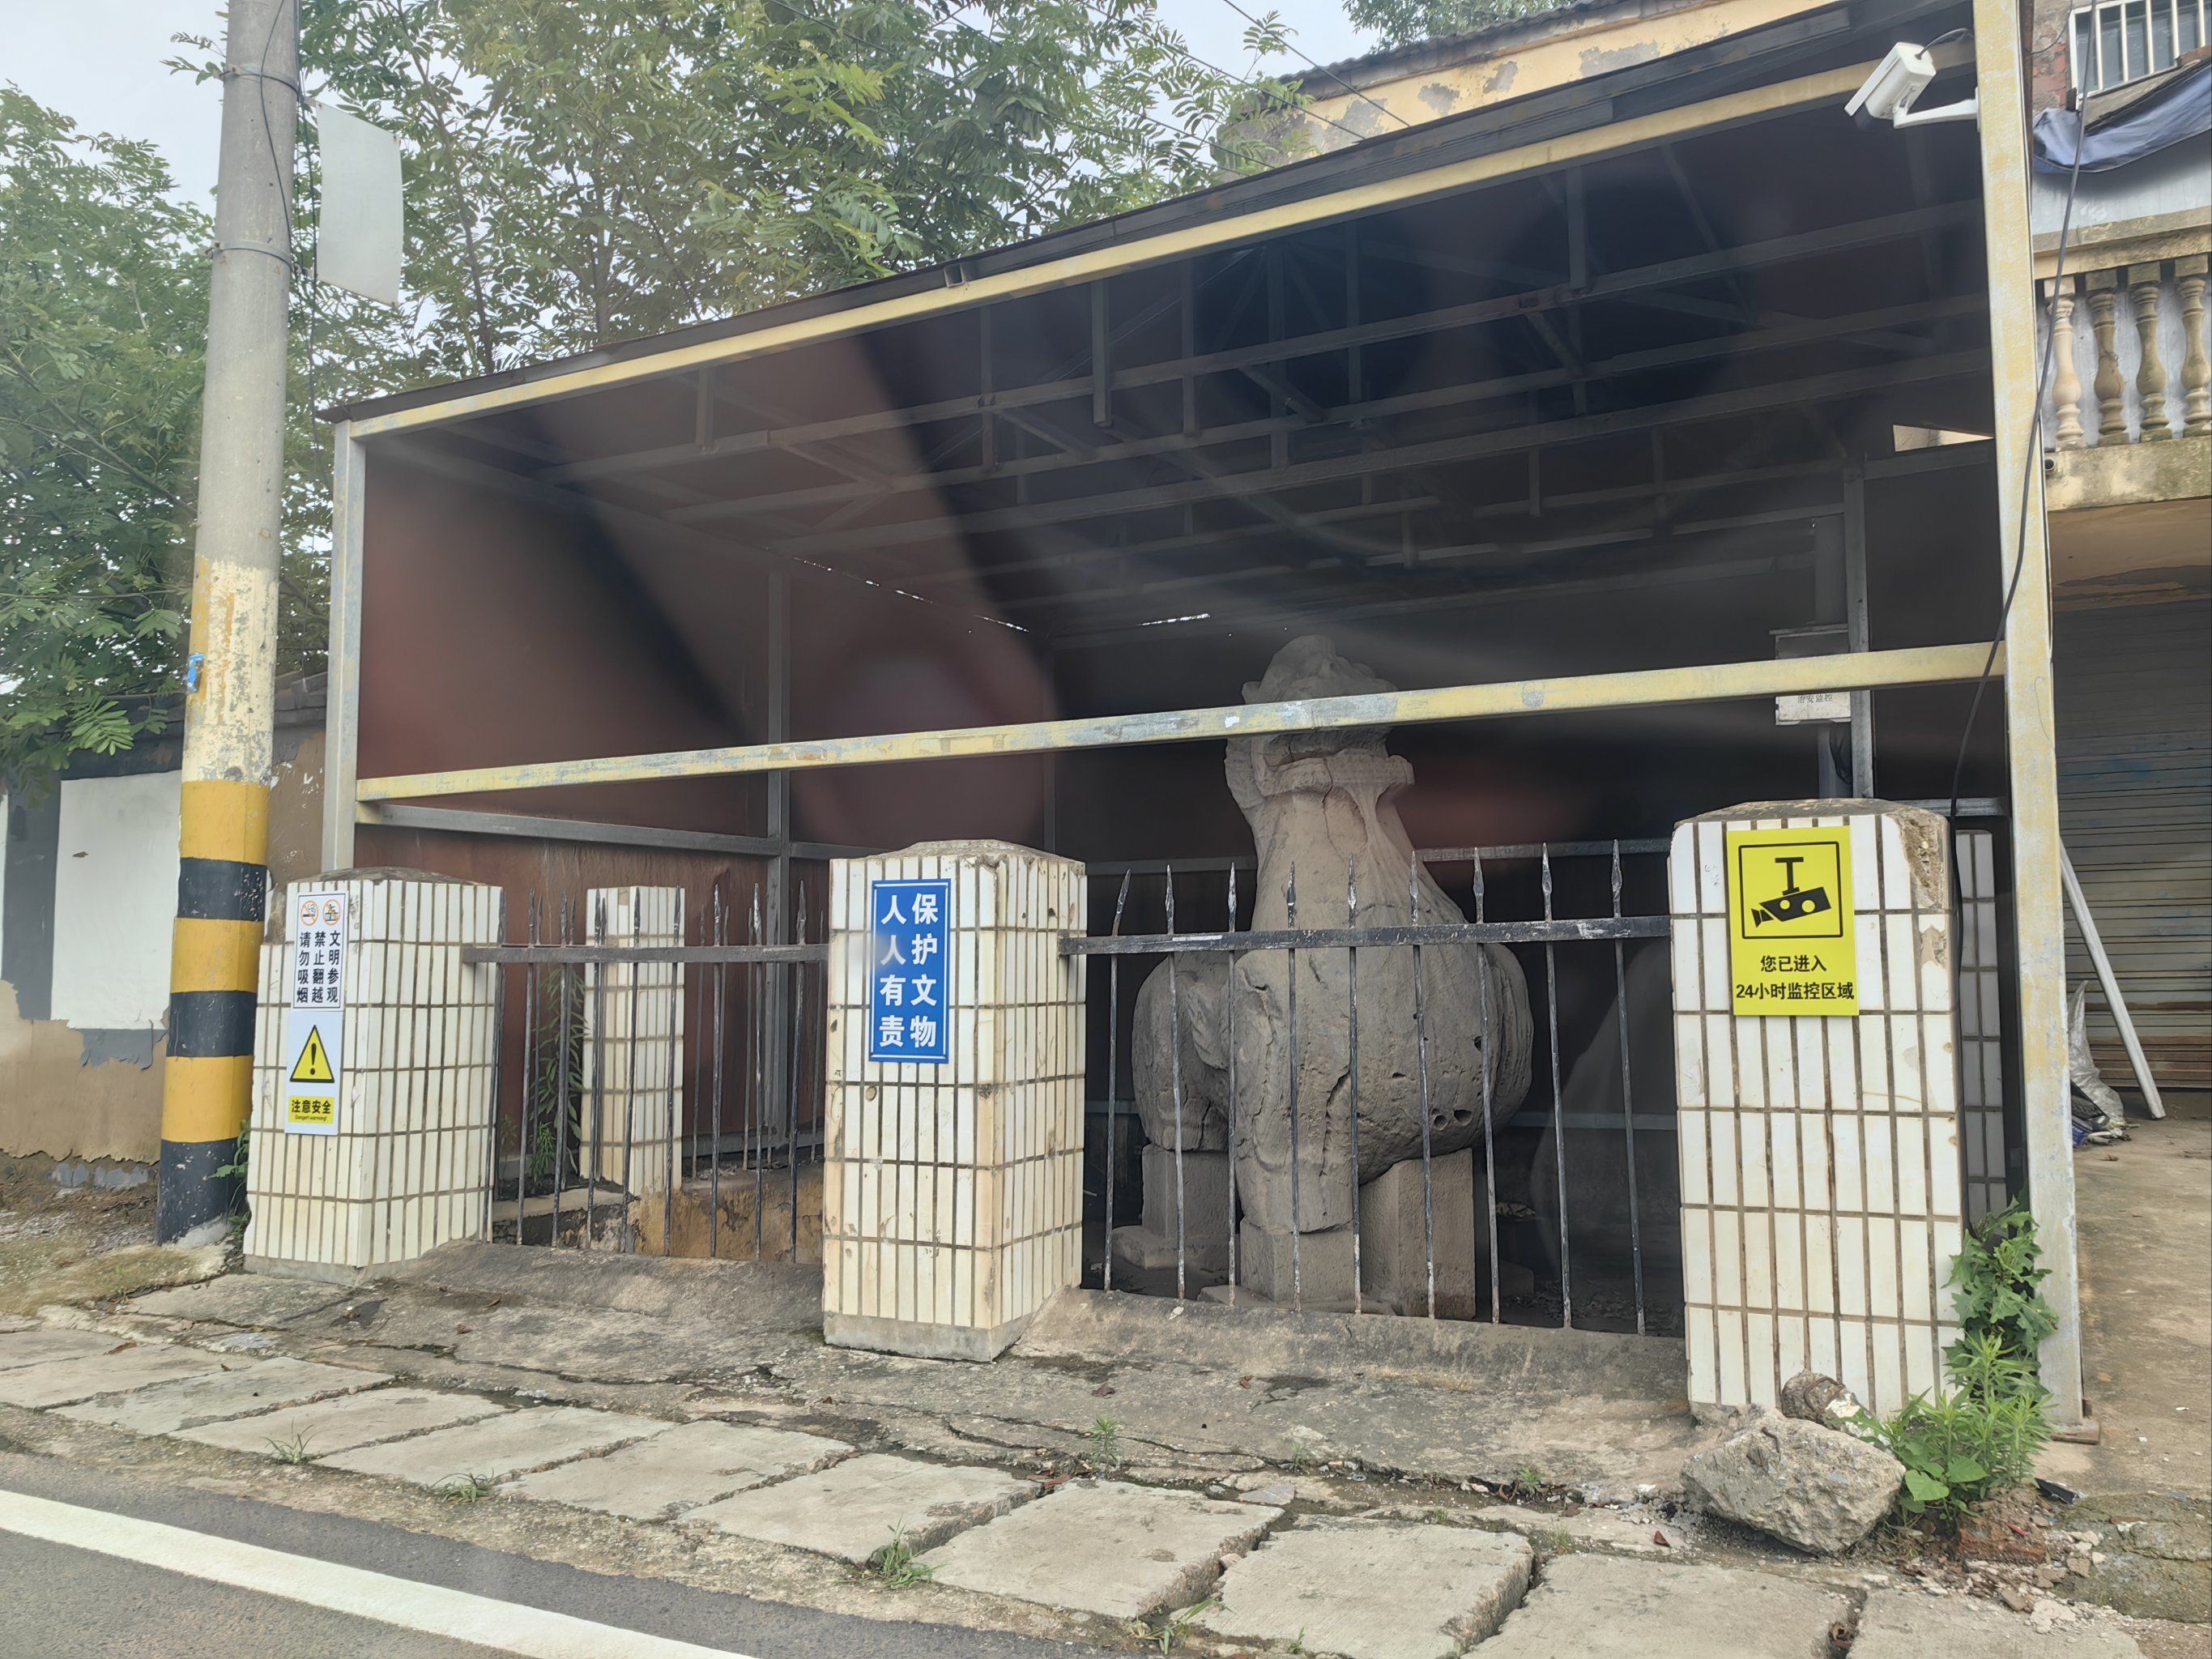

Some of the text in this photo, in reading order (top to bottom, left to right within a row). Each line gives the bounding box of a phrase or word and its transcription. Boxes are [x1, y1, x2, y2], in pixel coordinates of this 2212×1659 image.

[296, 931, 312, 1004] 请勿吸烟
[312, 931, 326, 1003] 禁止翻越
[326, 930, 341, 1003] 文明参观
[879, 894, 907, 1047] 人人有责
[910, 893, 939, 1047] 保护文物
[1736, 983, 1855, 1000] 24小时监控区域
[1760, 955, 1827, 973] 您已进入
[292, 1098, 330, 1114] 注意安全
